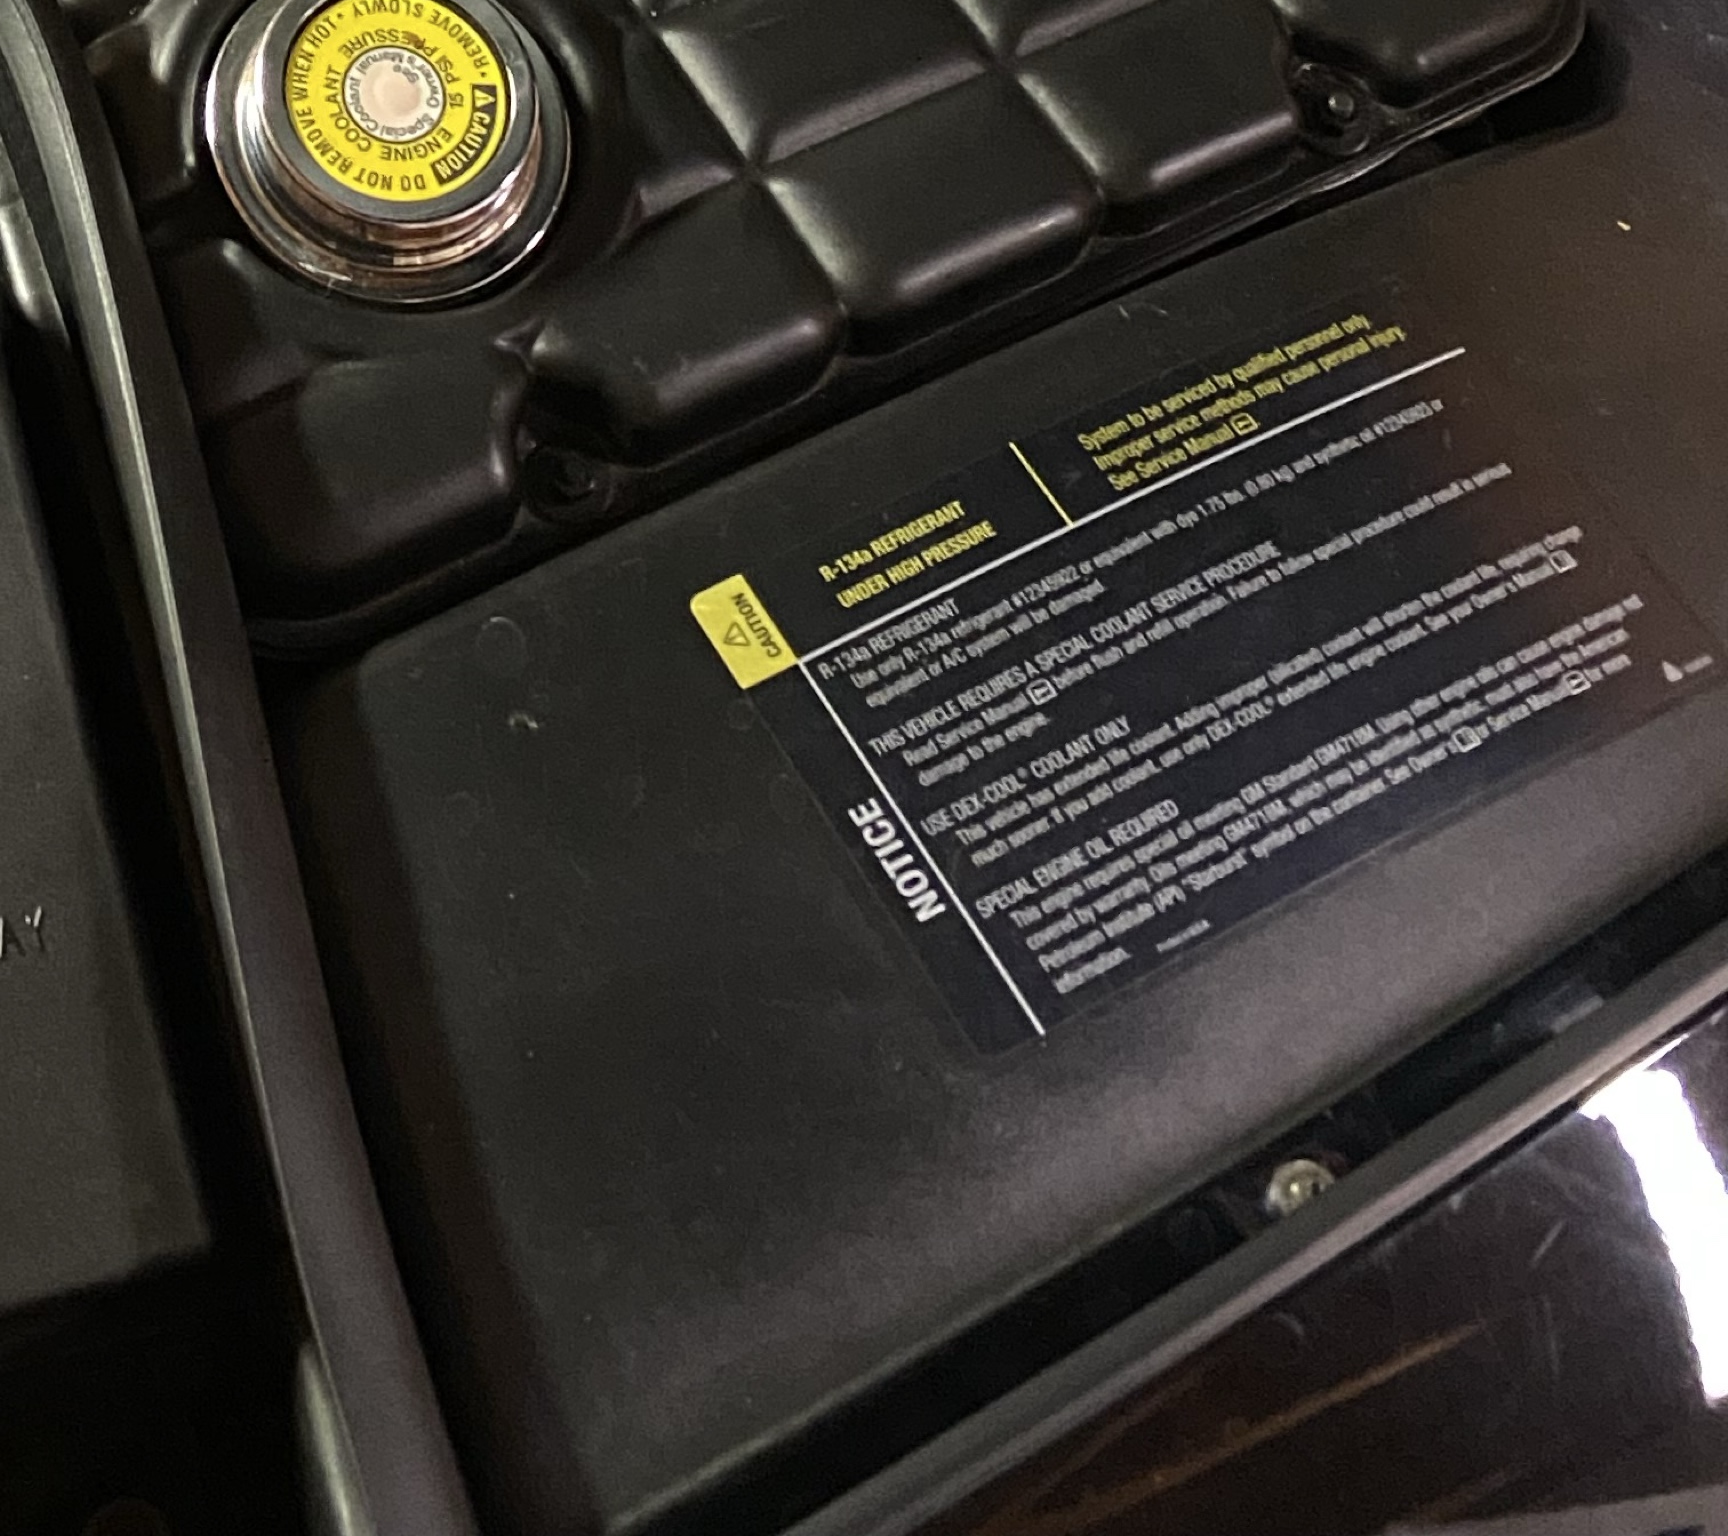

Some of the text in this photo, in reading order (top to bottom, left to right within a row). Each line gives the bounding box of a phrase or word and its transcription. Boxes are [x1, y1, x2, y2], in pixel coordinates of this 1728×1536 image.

[306, 13, 336, 50] HOT
[338, 29, 464, 109] 15 PSI PRESSURE
[355, 51, 405, 73] Manual
[427, 8, 489, 69] REMOVE
[291, 51, 313, 101] WHEN
[323, 65, 451, 161] ENGINE COOLANT
[350, 76, 433, 139] Special Coolant
[296, 107, 353, 171] REMOVE
[434, 112, 489, 177] CAUTION
[353, 168, 392, 191] NOT
[400, 174, 426, 192] DO
[1076, 419, 1130, 451] System
[1125, 412, 1146, 428] to
[1139, 404, 1164, 421] be
[1160, 377, 1217, 413] serviced
[1211, 372, 1235, 389] by
[1231, 346, 1287, 382] qualified
[1092, 336, 1370, 470] Improper service methods may cause personal
[1106, 422, 1235, 491] See Service Manual
[818, 500, 964, 582] R-134a REFRIGERANT
[836, 520, 996, 608] UNDER HIGH PRESSURE
[849, 668, 879, 689] Use
[876, 654, 906, 676] only
[901, 631, 952, 662] R-134a
[1078, 559, 1094, 575] or
[1149, 519, 1178, 540] with
[1291, 453, 1316, 474] and
[731, 592, 781, 658] CAUTION
[816, 597, 959, 679] R-134a REFRIGERANT
[867, 540, 1281, 756] THIS VEHICLE REQUIRES A SPECIAL COOLANT SERVICE PROCEDURE
[927, 660, 943, 677] or
[940, 646, 967, 669] A/C
[964, 627, 1011, 657] system
[1007, 613, 1033, 635] will
[1028, 607, 1050, 624] be
[901, 738, 939, 766] Read
[934, 718, 984, 750] Service
[979, 692, 1030, 725] Manual
[1050, 661, 1094, 690] before
[1121, 631, 1149, 655] and
[1263, 567, 1282, 583] to
[917, 733, 1006, 786] damage to the
[919, 807, 954, 836] USE
[1029, 733, 1095, 778] COOLANT
[1093, 715, 1130, 745] ONLY
[970, 838, 1009, 866] much
[1062, 797, 1089, 821] you
[1085, 781, 1114, 806] add
[1158, 746, 1184, 768] use
[1181, 733, 1211, 755] only
[954, 823, 987, 845] This
[984, 799, 1031, 831] vehicle
[1025, 787, 1055, 808] has
[1008, 904, 1042, 928] This
[1039, 881, 1085, 914] engine
[1239, 781, 1266, 805] GM
[848, 798, 945, 921] NOTICE
[974, 798, 1179, 919] SPECIAL ENGINE OIL REQUIRED
